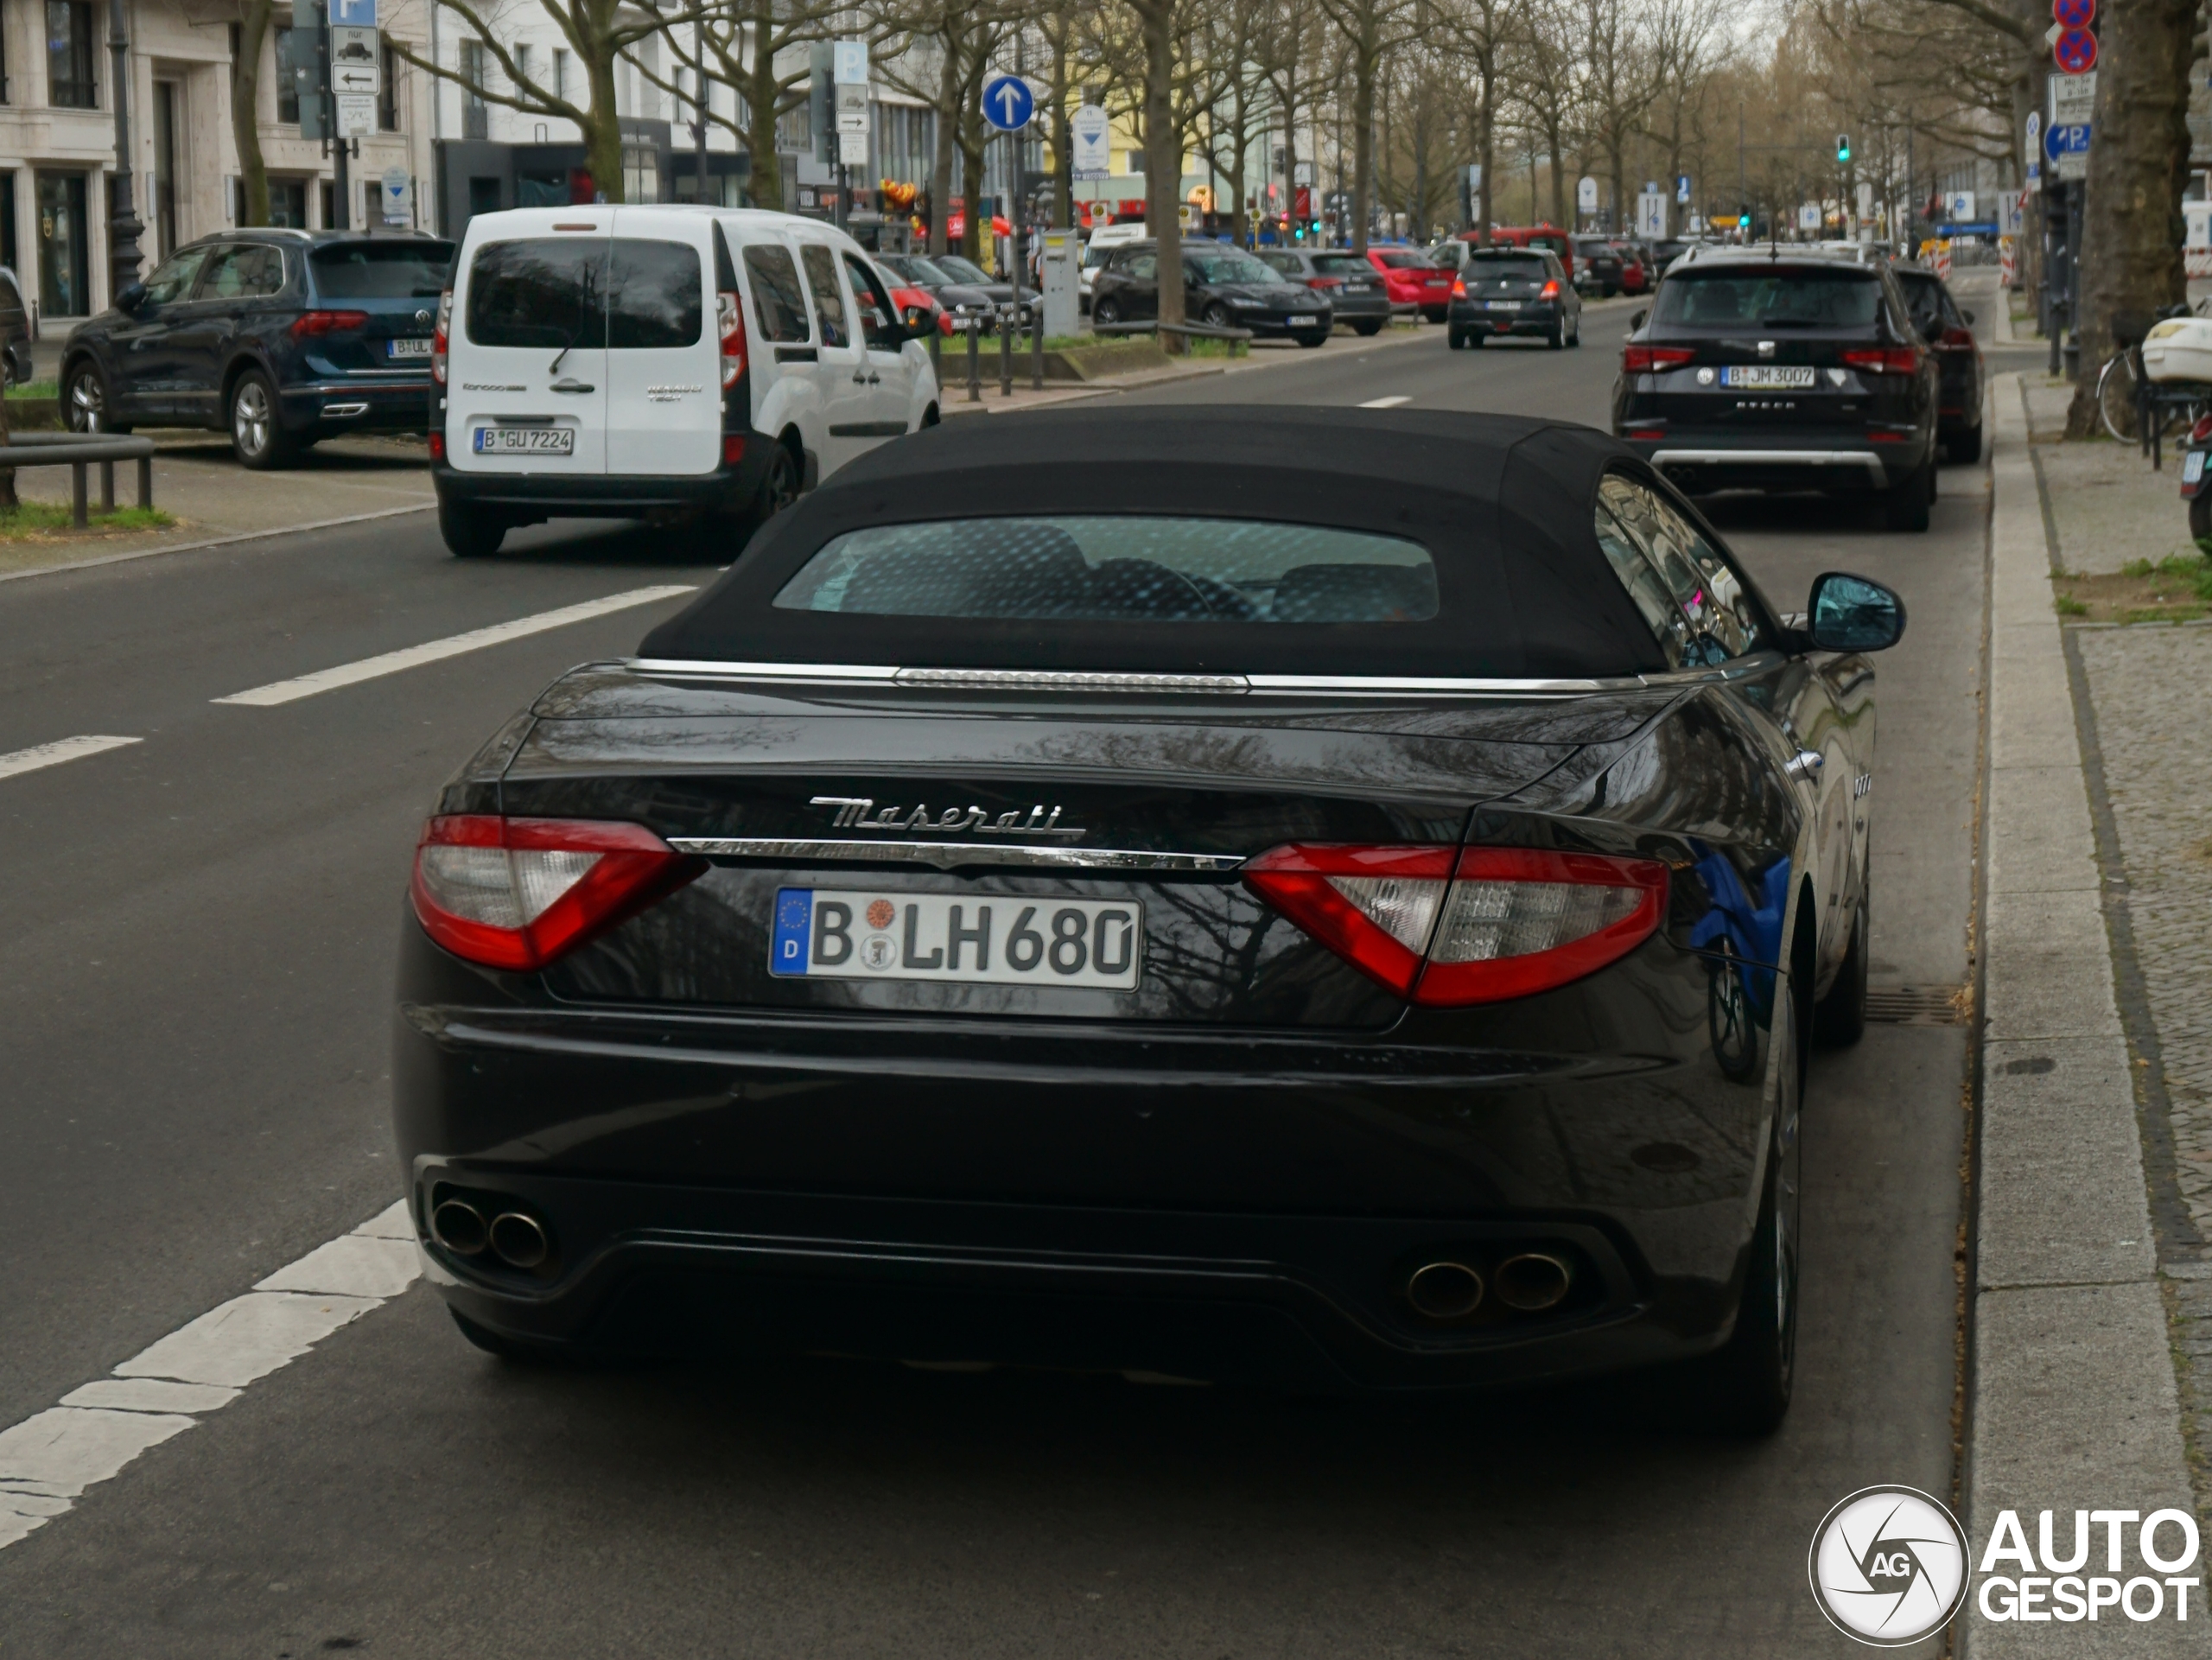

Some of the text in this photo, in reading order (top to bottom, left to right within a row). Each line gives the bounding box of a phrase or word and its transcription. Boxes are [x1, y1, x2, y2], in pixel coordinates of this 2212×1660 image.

[347, 30, 363, 39] nur
[2069, 126, 2084, 149] P
[397, 340, 405, 353] B
[1731, 368, 1813, 383] B JM 3007
[647, 385, 704, 394] RENAULT
[647, 394, 681, 403] TECH
[485, 431, 495, 448] B
[506, 431, 527, 448] GU
[531, 431, 569, 448] 7224
[809, 796, 1087, 836] Maserati
[784, 939, 798, 959] D
[811, 900, 854, 966] B
